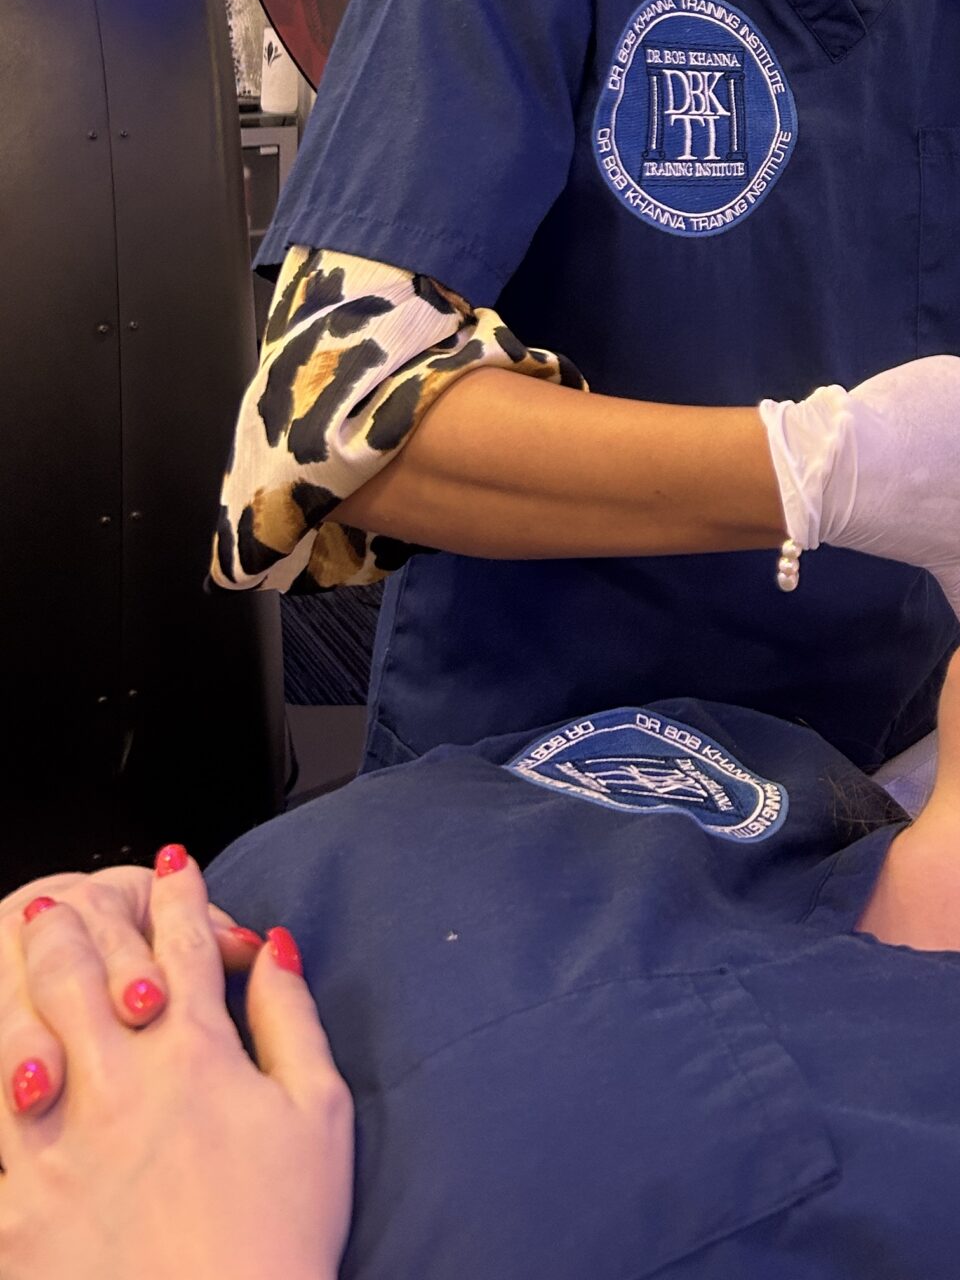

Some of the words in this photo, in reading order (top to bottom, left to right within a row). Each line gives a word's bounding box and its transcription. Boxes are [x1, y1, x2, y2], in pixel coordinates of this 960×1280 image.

[608, 65, 624, 90] DR
[618, 31, 637, 63] BOB
[739, 24, 786, 94] INSTITUTE
[646, 49, 663, 64] DR
[664, 50, 687, 65] BOB
[689, 51, 742, 67] KHANNA
[662, 69, 731, 116] DBK
[597, 127, 612, 153] DR
[602, 156, 627, 190] BOB
[643, 162, 694, 177] TRAINING
[695, 163, 745, 177] INSTITUTE
[746, 130, 792, 204] INSTITUTE
[625, 188, 687, 231] KHANNA
[689, 201, 748, 231] TRAINING
[569, 720, 595, 739] DR
[636, 713, 660, 733] DR
[663, 726, 702, 750] BOB
[530, 735, 567, 759] BOB
